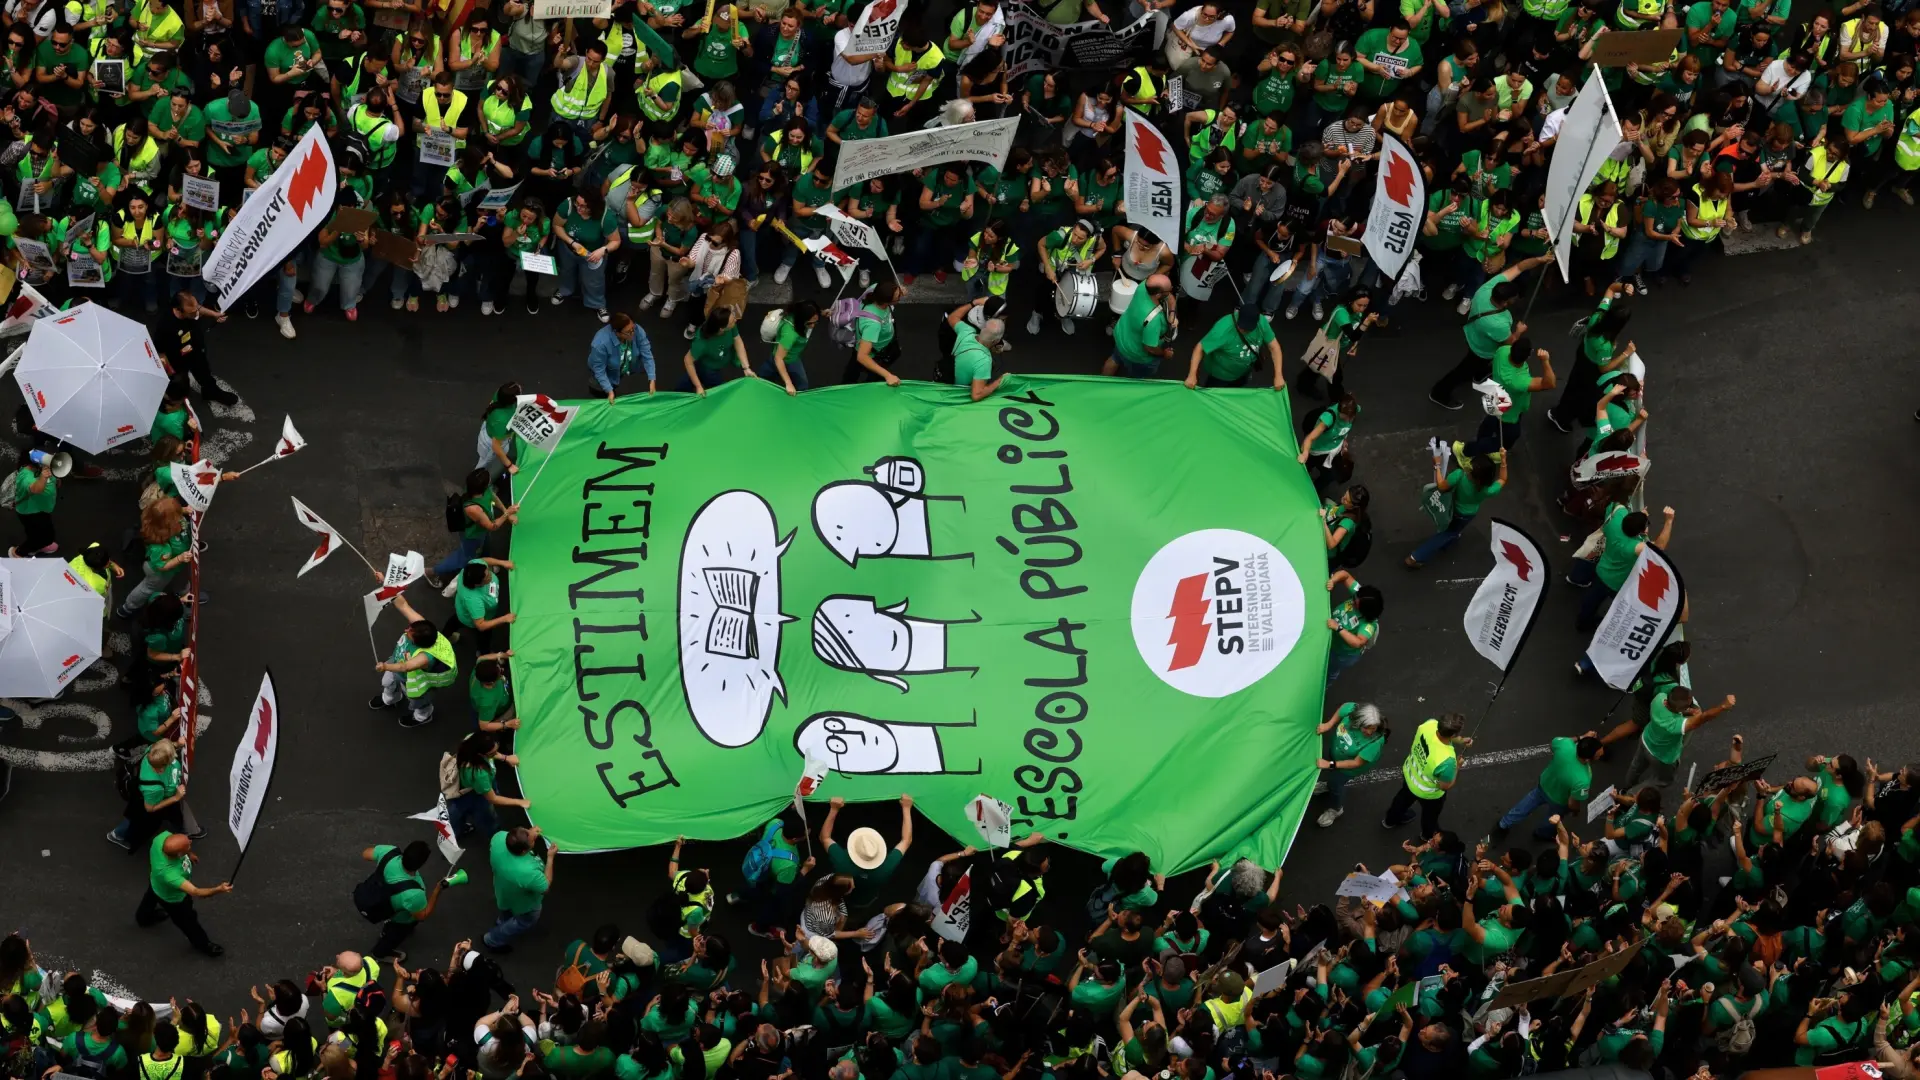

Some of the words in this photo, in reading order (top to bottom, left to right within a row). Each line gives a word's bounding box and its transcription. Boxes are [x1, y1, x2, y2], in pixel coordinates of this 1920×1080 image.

[568, 442, 679, 808] ESTIMEM
[1213, 556, 1244, 655] STEPV
[1244, 552, 1260, 652] INTERSINDICAL
[1257, 551, 1274, 635] VALENCIANA
[1010, 617, 1089, 840] 'ESCOLA
